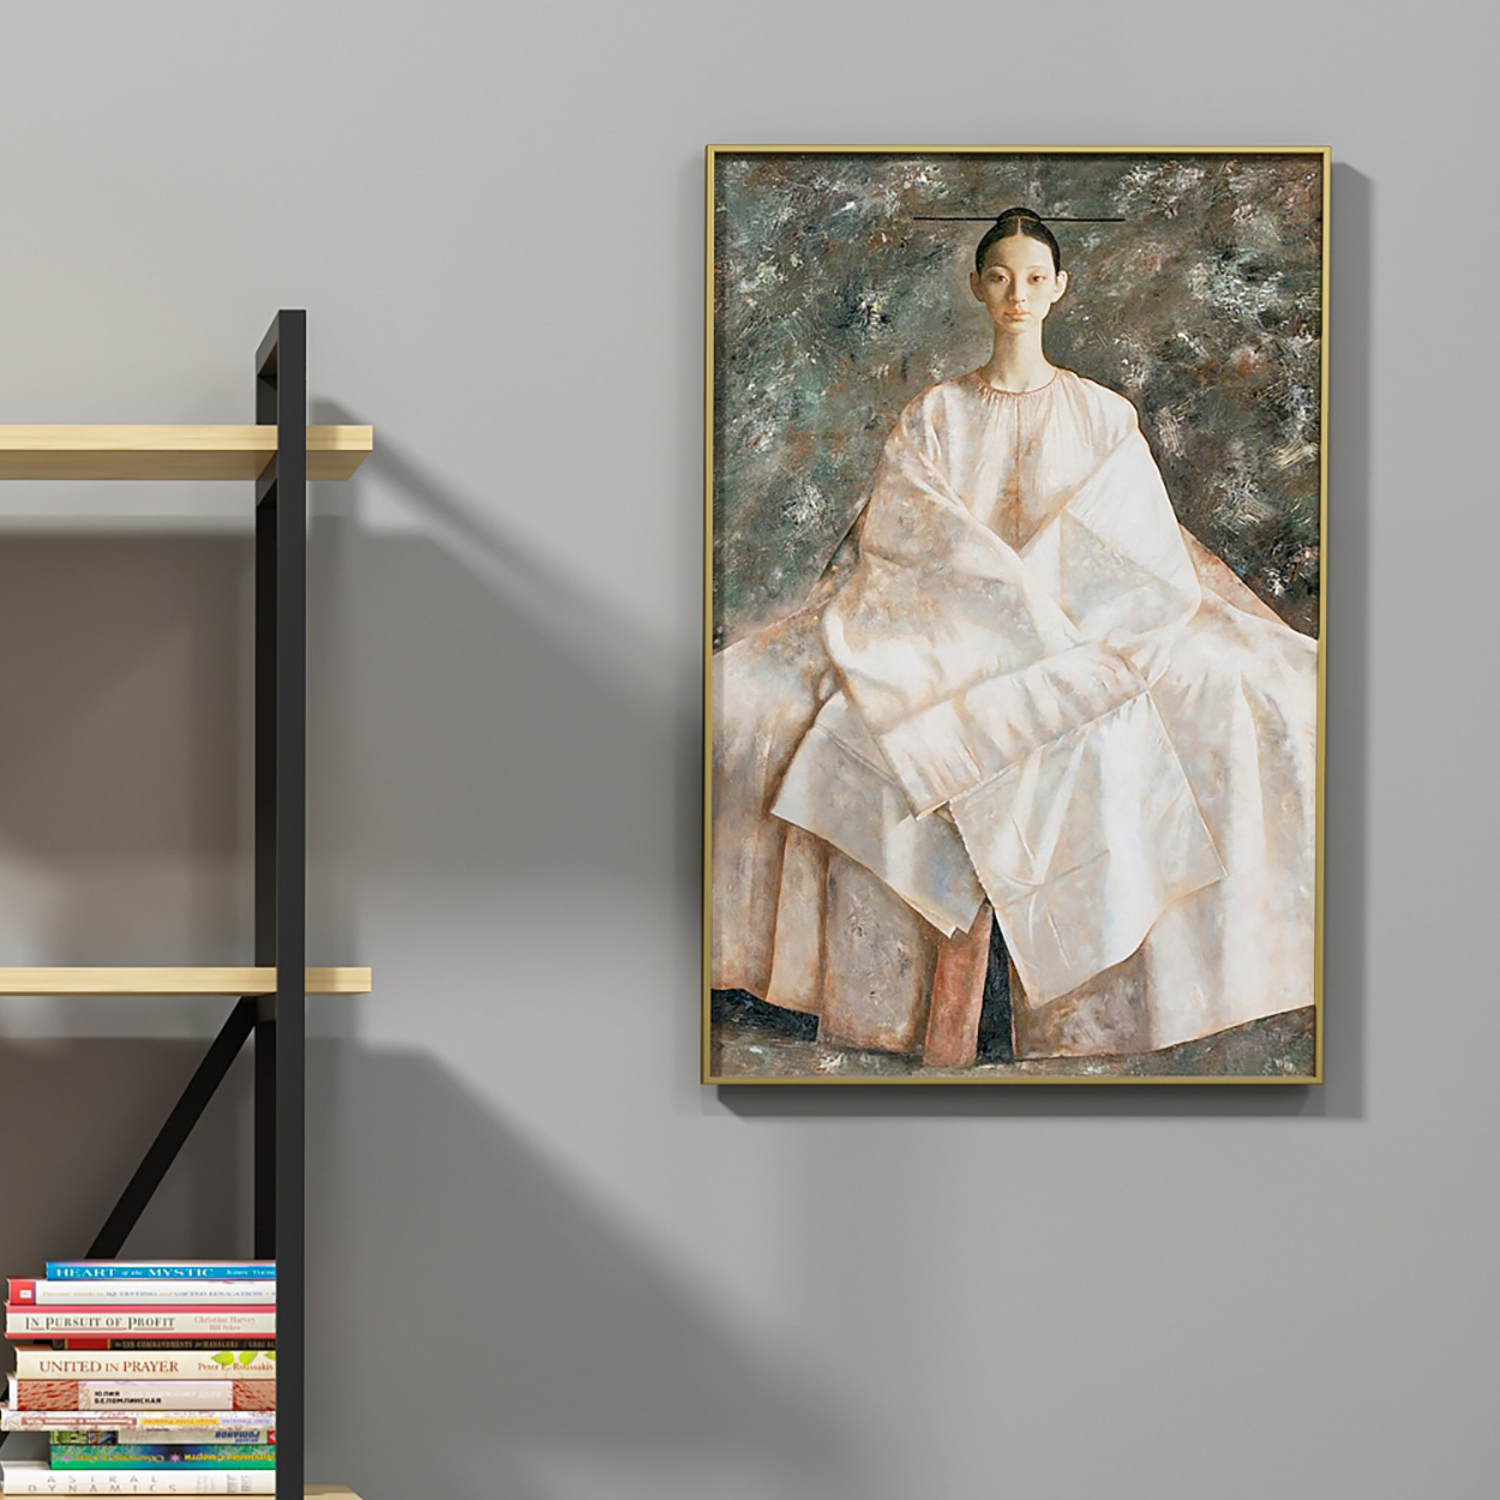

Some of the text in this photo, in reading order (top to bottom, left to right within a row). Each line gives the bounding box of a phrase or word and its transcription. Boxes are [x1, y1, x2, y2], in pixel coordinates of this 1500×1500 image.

[56, 1268, 116, 1277] HEART
[148, 1268, 214, 1277] MYSTIC
[25, 1317, 175, 1330] IN PURSUIT OF PROFIT
[39, 1361, 179, 1373] UNITED IN PRAYER
[197, 1362, 219, 1371] Peter
[28, 1484, 177, 1492] DYNAMICS
